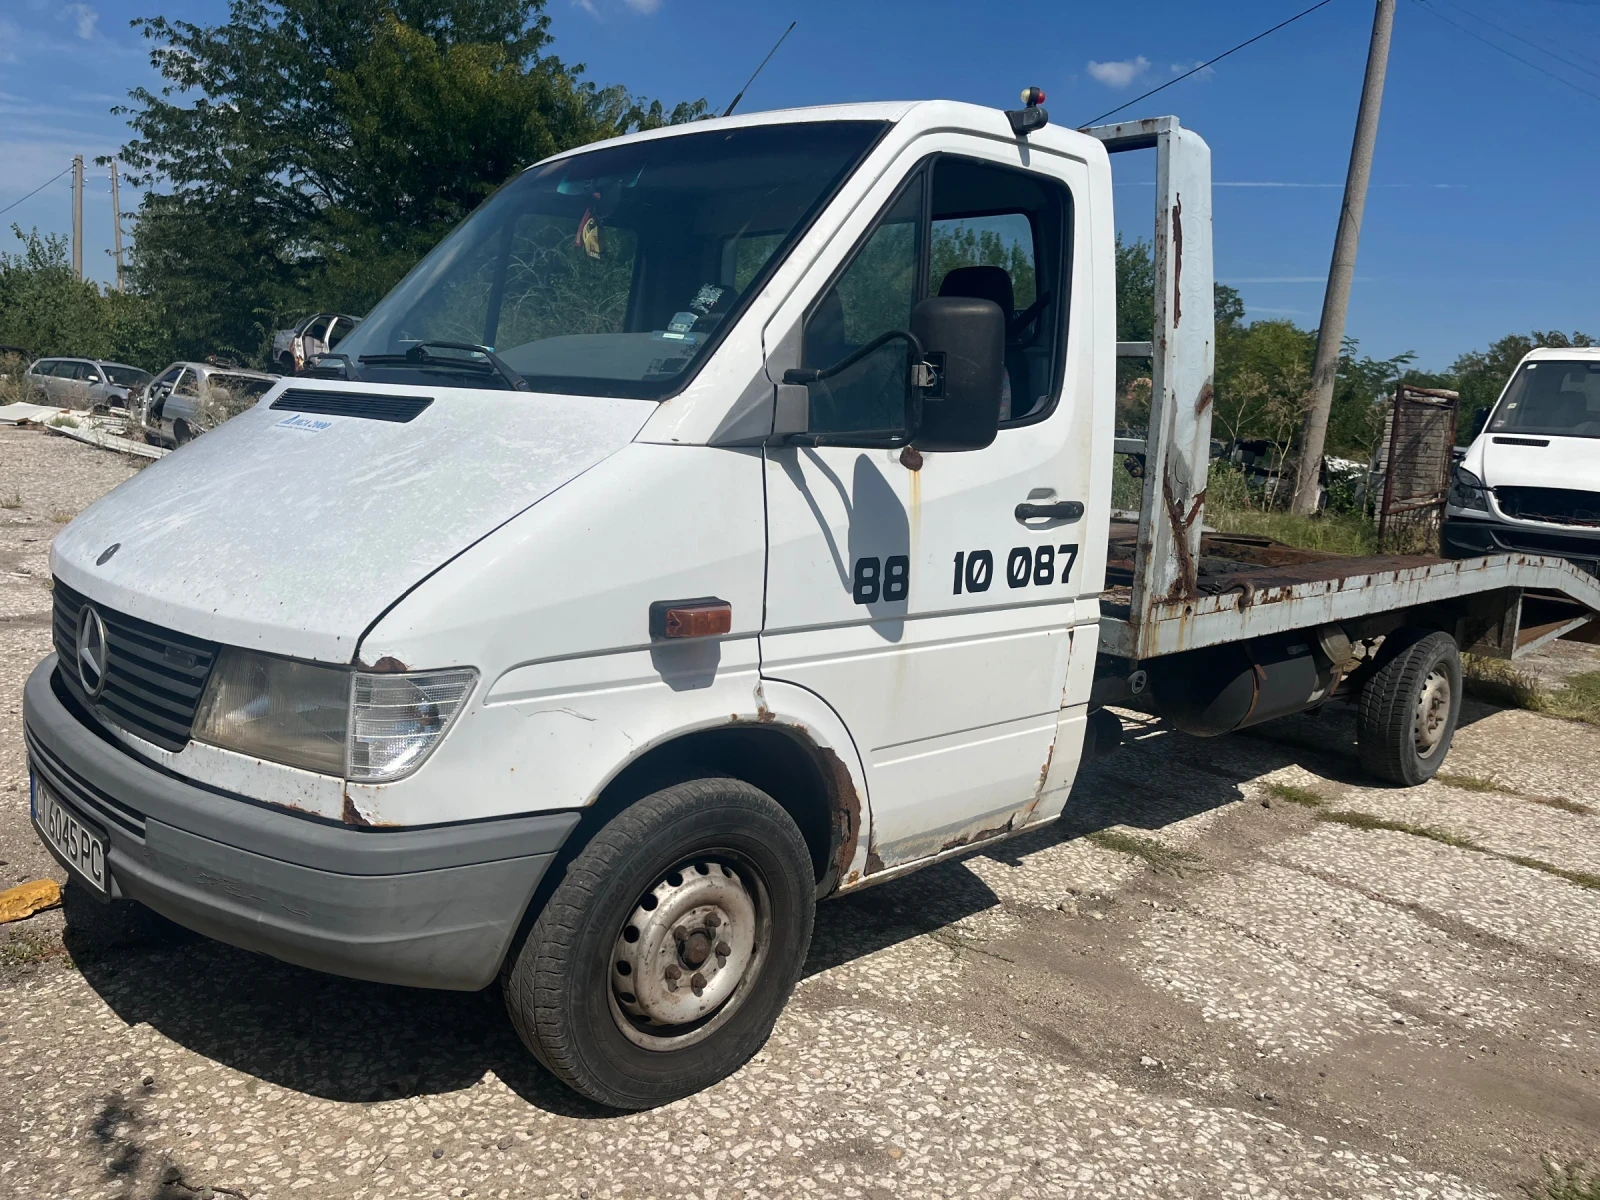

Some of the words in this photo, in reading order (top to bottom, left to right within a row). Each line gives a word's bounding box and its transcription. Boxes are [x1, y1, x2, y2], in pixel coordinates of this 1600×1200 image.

[853, 555, 909, 604] 88
[952, 550, 994, 595] 10
[1006, 544, 1079, 589] 087
[49, 799, 79, 859] 6045
[81, 827, 104, 881] PC
